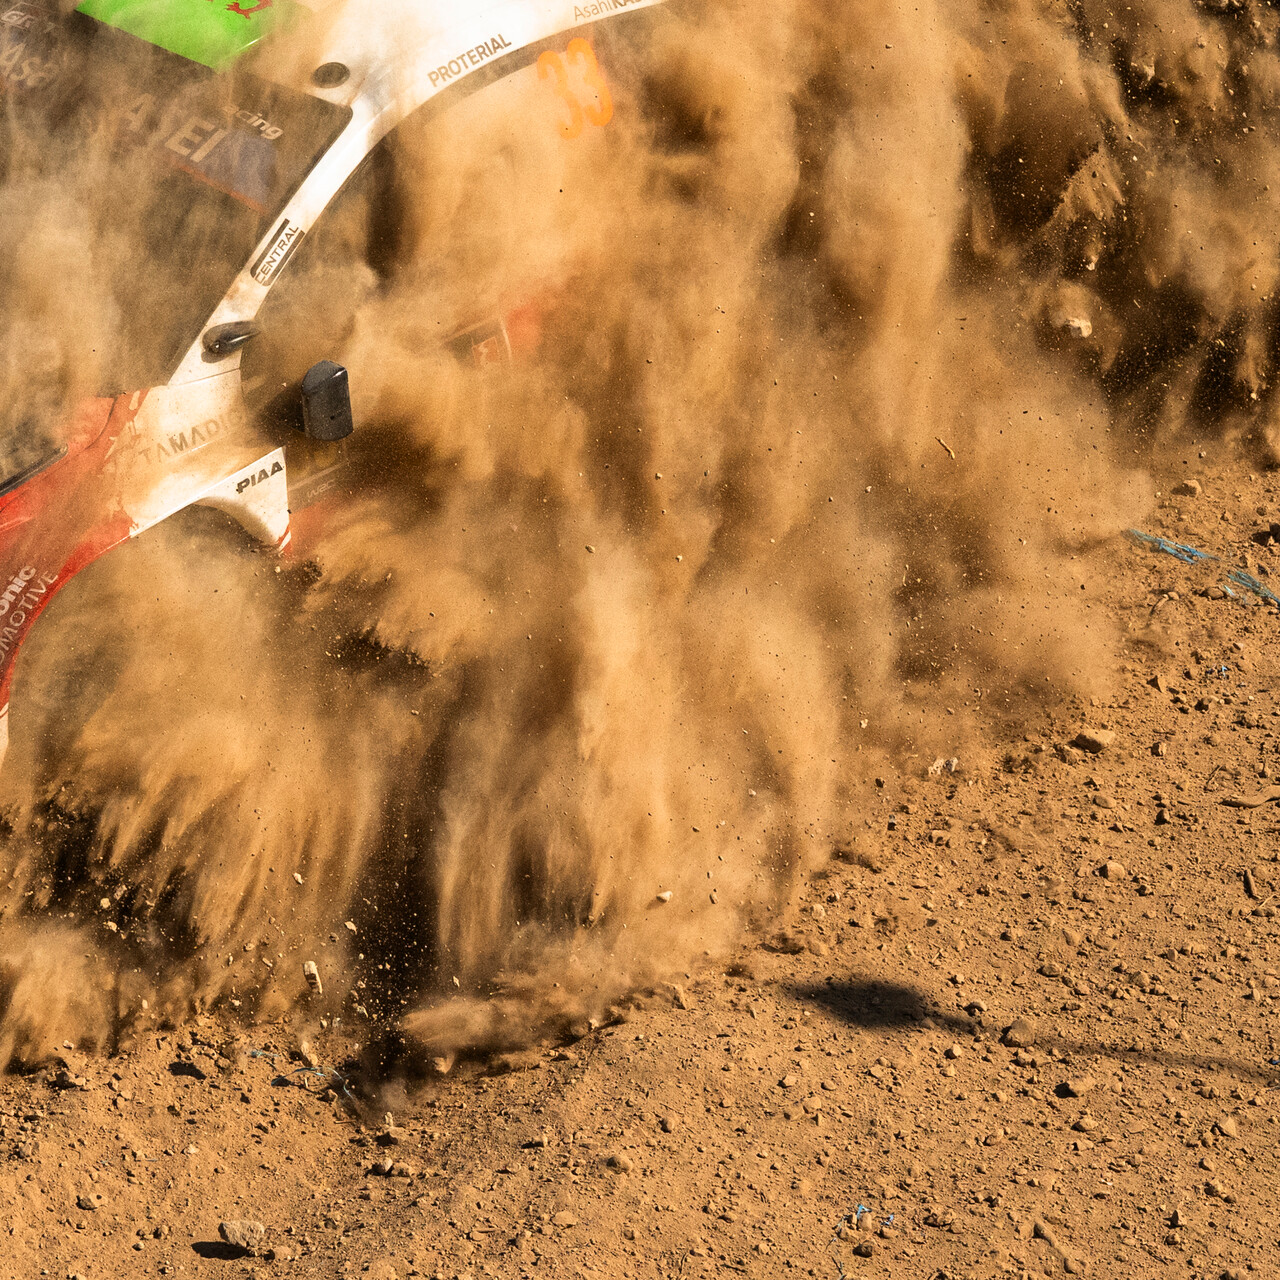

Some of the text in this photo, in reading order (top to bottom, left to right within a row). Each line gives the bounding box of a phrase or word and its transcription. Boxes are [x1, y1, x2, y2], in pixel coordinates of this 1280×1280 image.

[427, 33, 512, 88] PROTERIAL
[537, 37, 614, 140] 33
[255, 226, 299, 286] CENTRAL
[236, 461, 284, 494] PIAA
